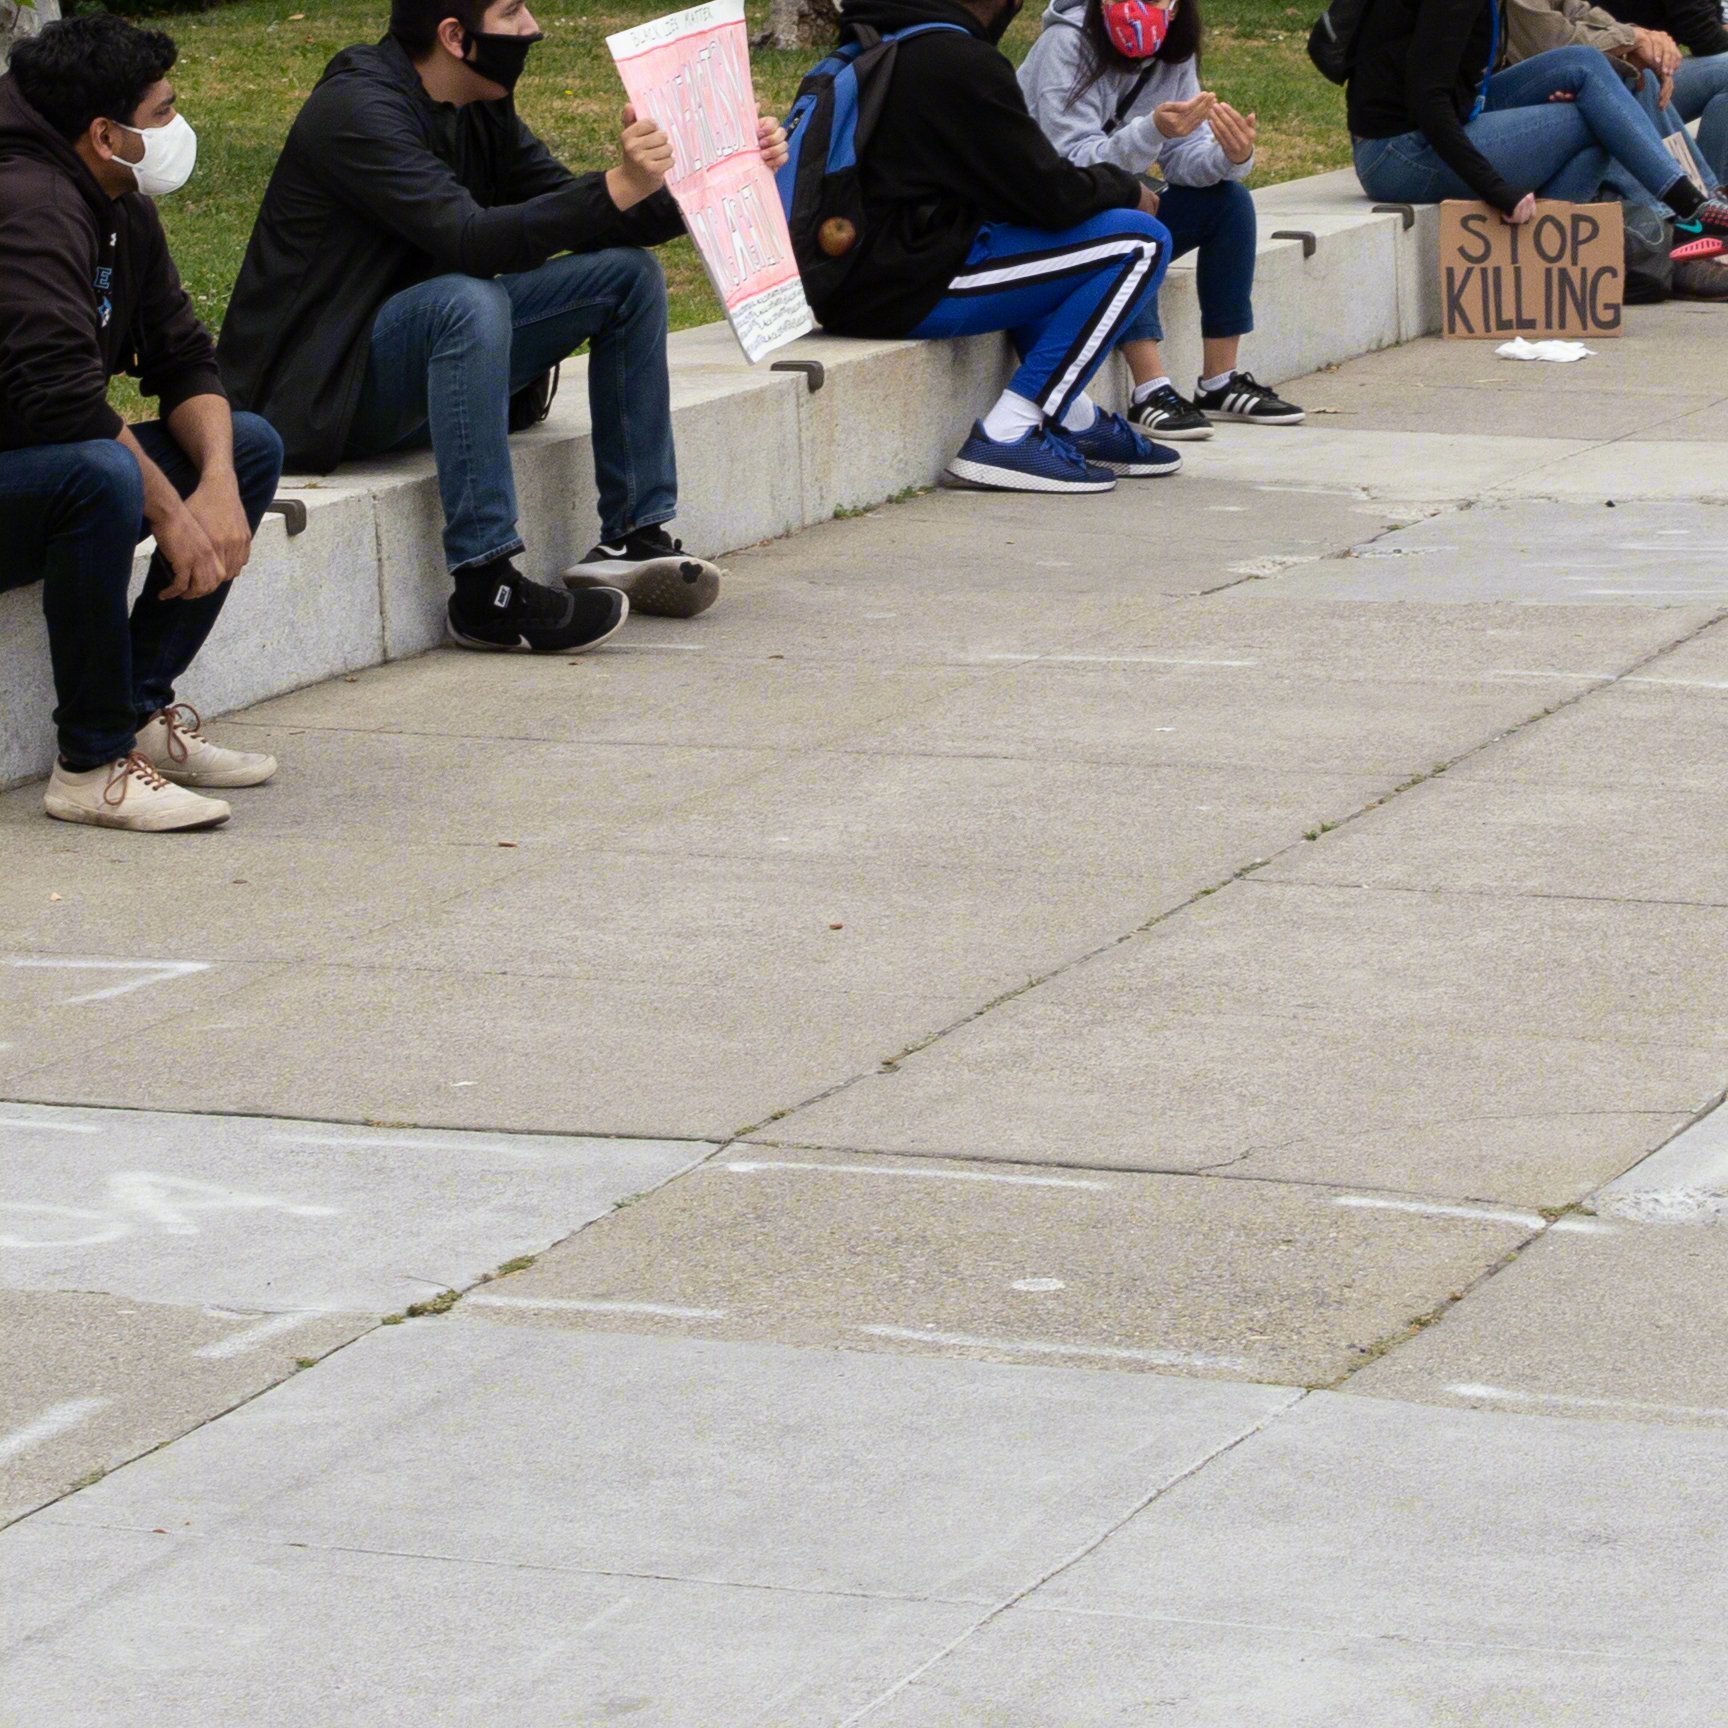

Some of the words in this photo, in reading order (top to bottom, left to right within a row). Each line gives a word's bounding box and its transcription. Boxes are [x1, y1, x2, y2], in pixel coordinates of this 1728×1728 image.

[630, 25, 663, 47] BLACK
[683, 6, 714, 27] MATTER
[1457, 213, 1600, 267] STOP
[1445, 264, 1622, 335] KILLING
